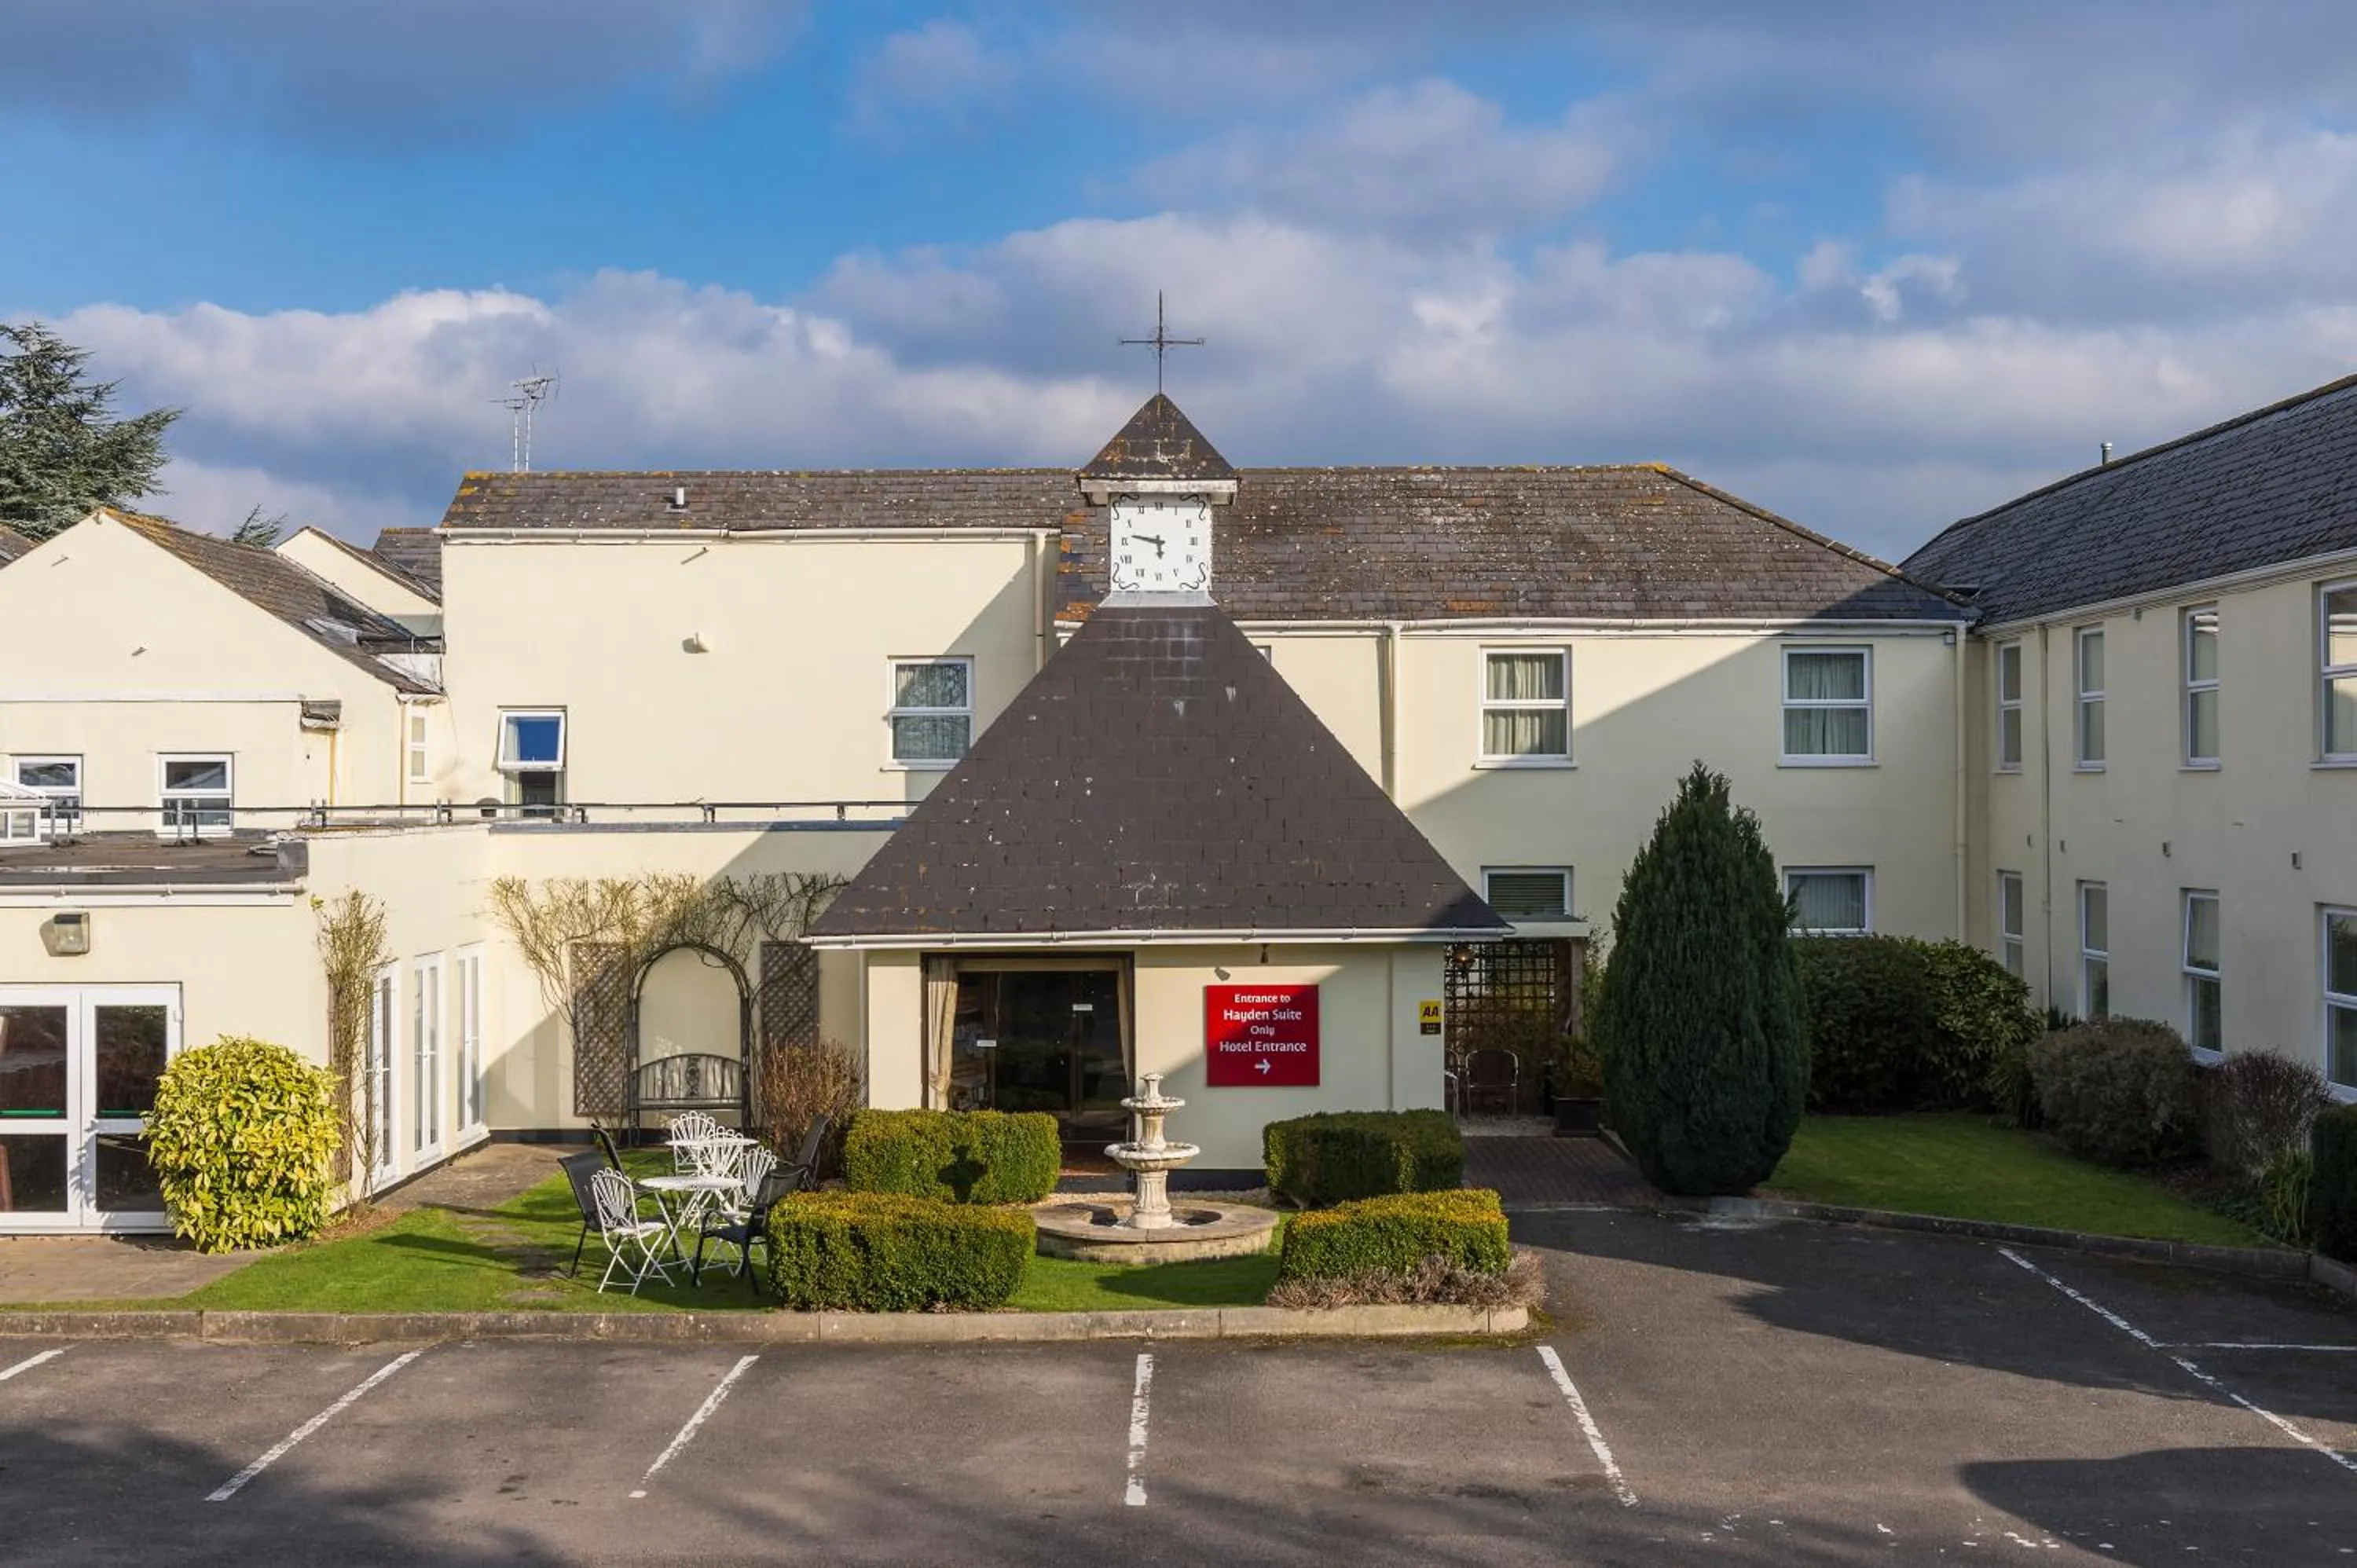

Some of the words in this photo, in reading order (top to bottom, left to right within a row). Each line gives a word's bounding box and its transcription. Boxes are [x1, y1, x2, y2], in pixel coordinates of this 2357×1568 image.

[1138, 505, 1145, 515] XI
[1126, 519, 1132, 528] X
[1186, 519, 1192, 528] II
[1121, 537, 1128, 546] IX
[1189, 537, 1198, 546] III
[1120, 555, 1132, 564] VIII
[1186, 555, 1193, 563] IV
[1135, 568, 1145, 577] VII
[1154, 572, 1162, 581] VI
[1173, 568, 1179, 577] V
[1234, 994, 1278, 1003] Entrance
[1280, 995, 1291, 1003] to
[1223, 1009, 1269, 1023] Hayden
[1272, 1009, 1302, 1020] Suite
[1423, 1006, 1439, 1017] AA
[1250, 1025, 1275, 1036] Only
[1219, 1041, 1252, 1052] Hotel
[1255, 1041, 1307, 1052] Entrance
